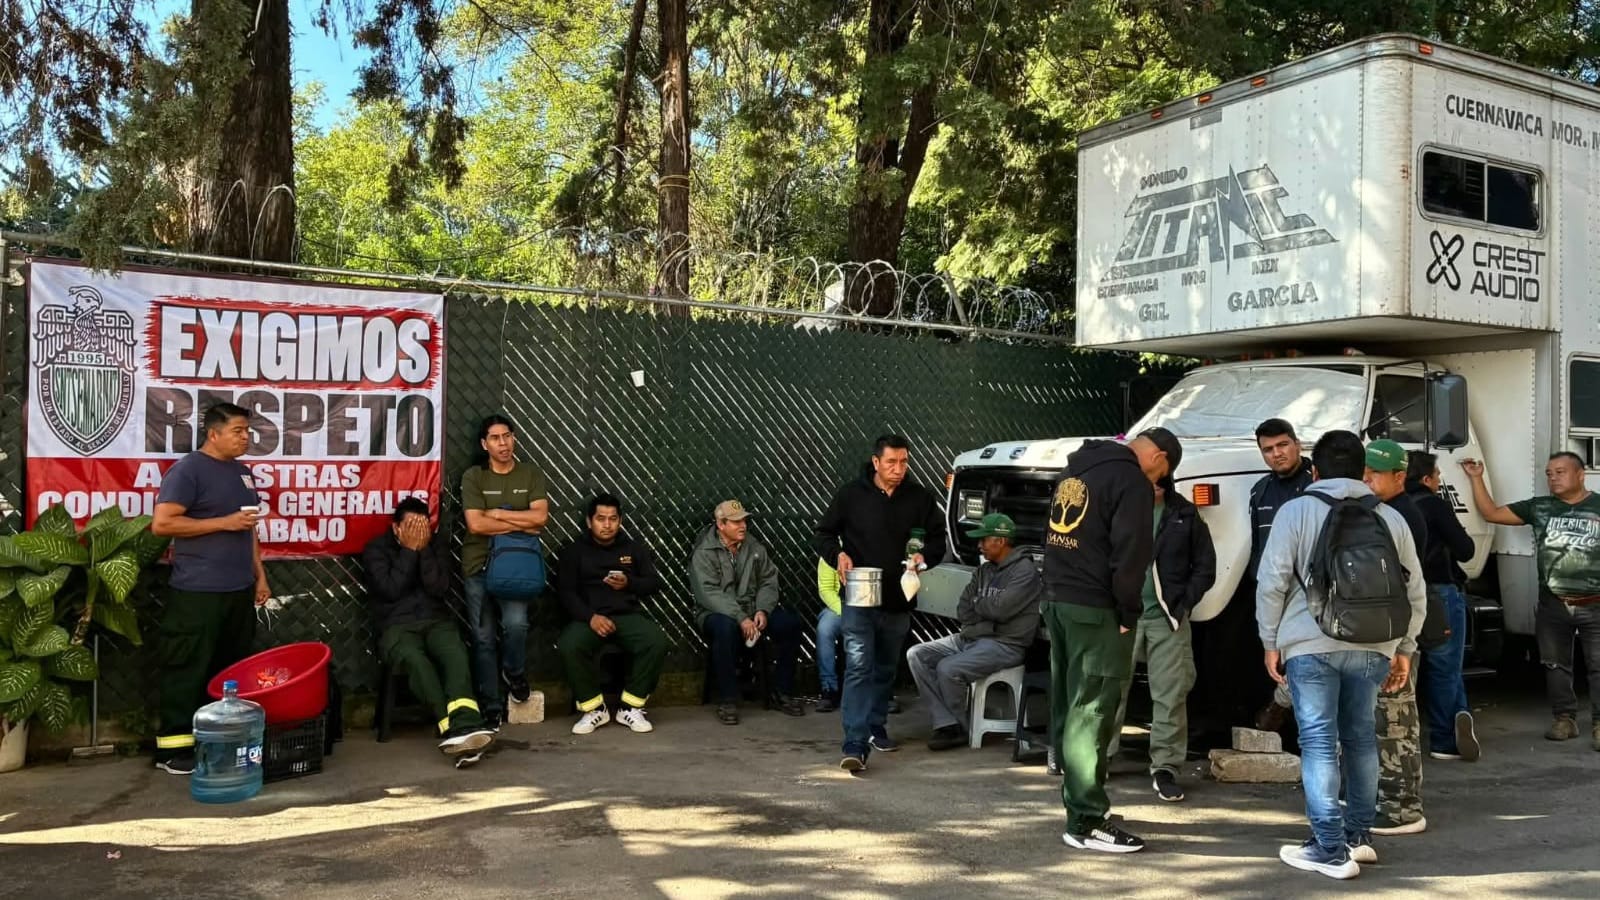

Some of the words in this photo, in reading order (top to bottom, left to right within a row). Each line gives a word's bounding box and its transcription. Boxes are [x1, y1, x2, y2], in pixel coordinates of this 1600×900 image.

[1446, 94, 1543, 137] CUERNAVACA
[1551, 121, 1587, 148] MOR.
[1473, 241, 1546, 275] CREST
[1227, 281, 1319, 313] GARCIA
[1470, 271, 1540, 303] AUDIO
[160, 304, 431, 385] EXIGIMOS
[70, 352, 103, 365] 1995
[42, 378, 50, 399] POR
[122, 375, 131, 409] PUEBLO
[45, 400, 55, 413] UN
[114, 411, 124, 426] DEL
[50, 415, 75, 442] ESTADO
[87, 426, 116, 451] SERVICIO
[75, 442, 86, 450] AL
[133, 462, 162, 488] A
[245, 463, 361, 489] STRAS
[256, 517, 346, 543] ABAJO
[1546, 516, 1599, 538] AMERICAN
[1545, 530, 1598, 551] Eagle
[1091, 828, 1115, 845] PUMA
